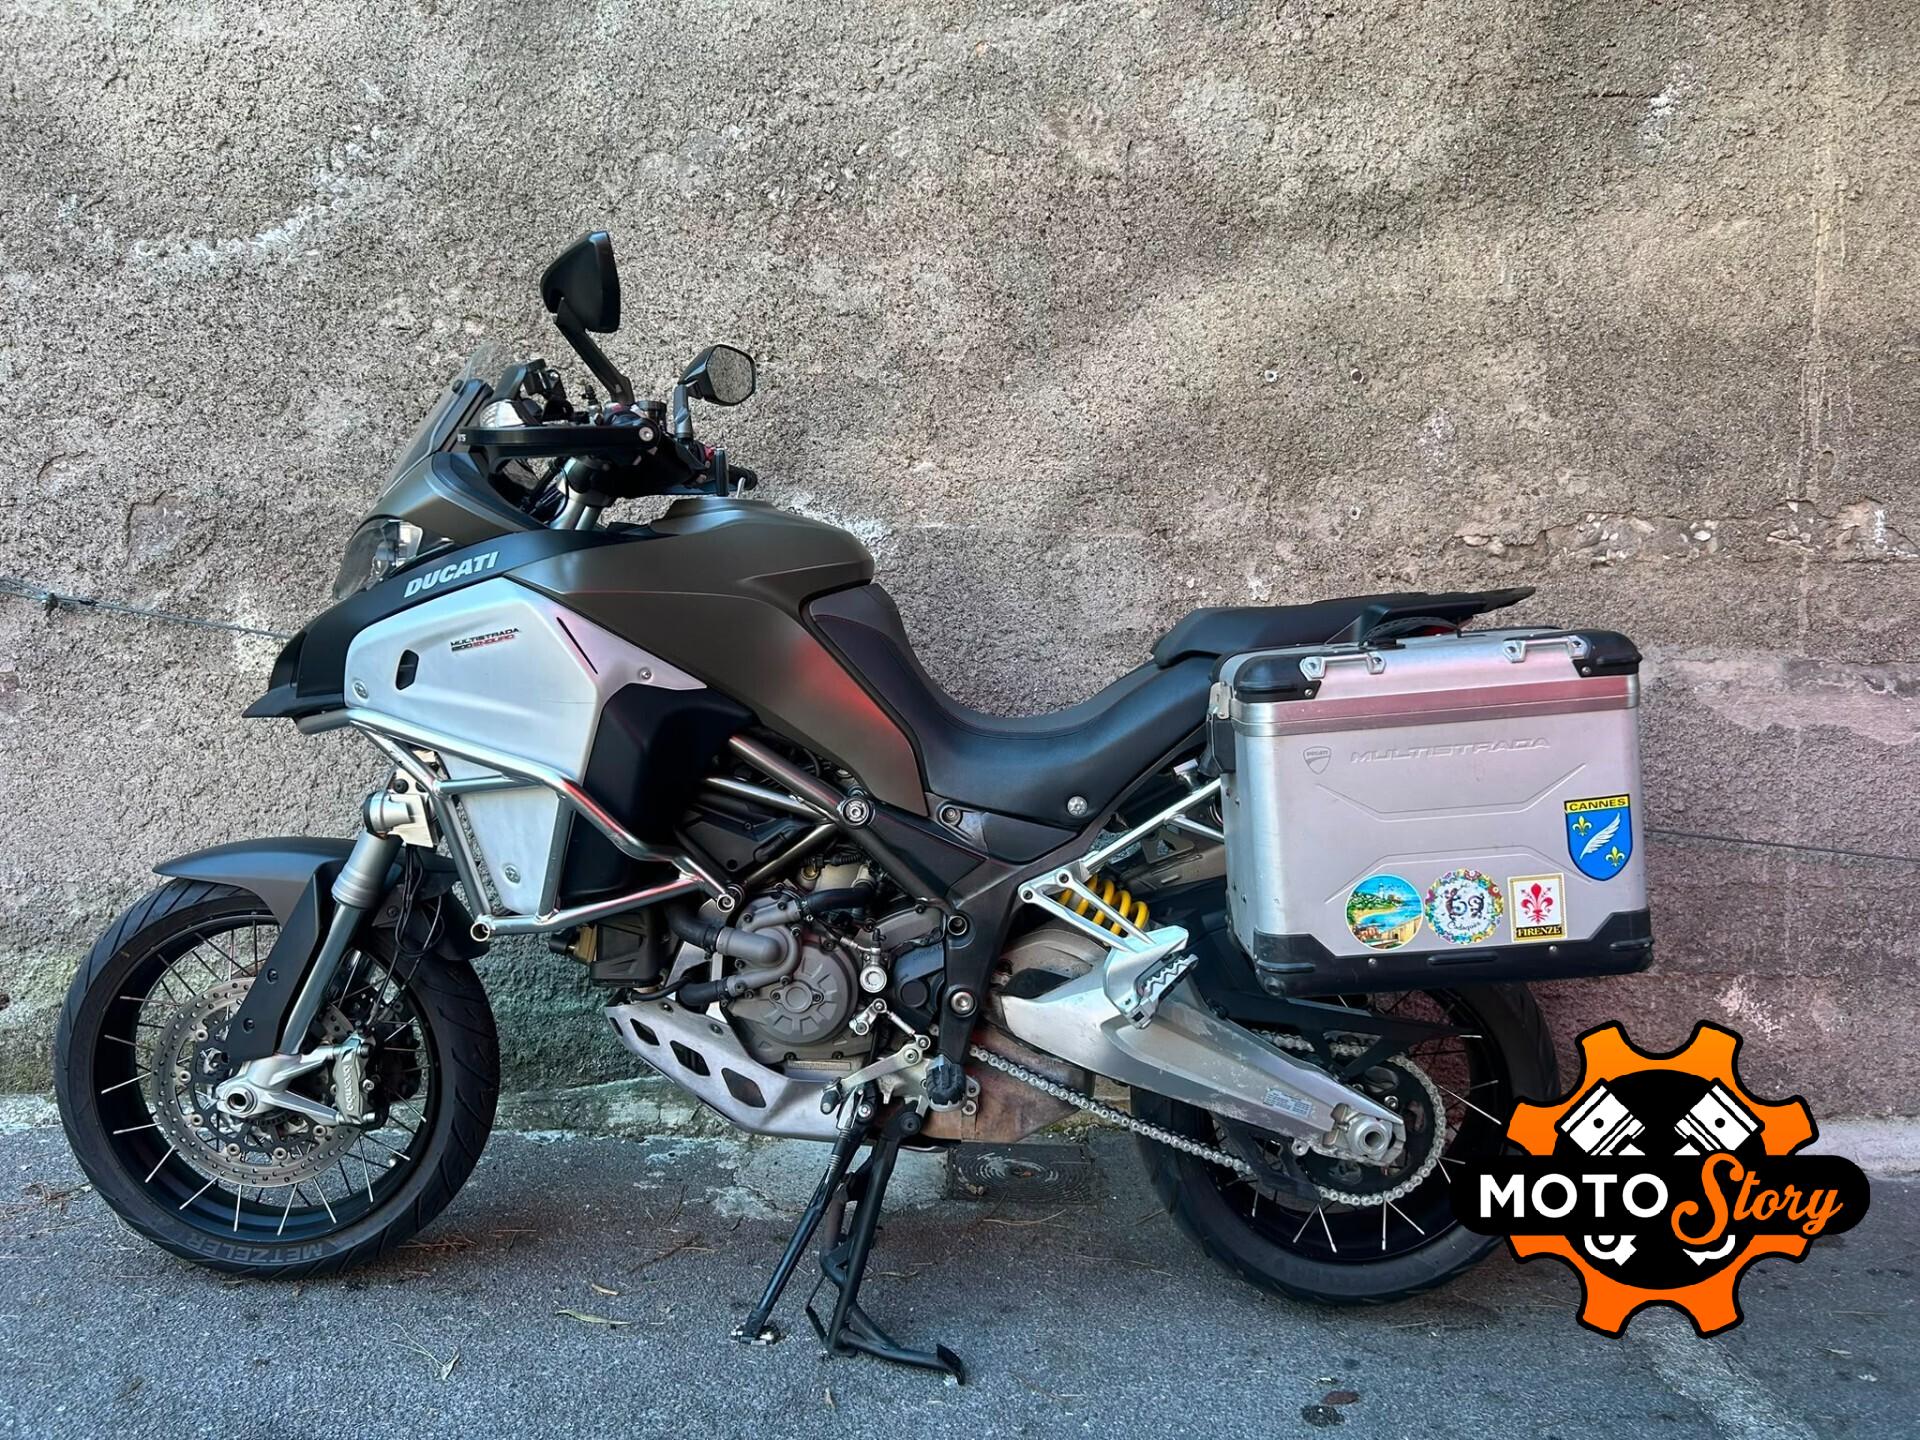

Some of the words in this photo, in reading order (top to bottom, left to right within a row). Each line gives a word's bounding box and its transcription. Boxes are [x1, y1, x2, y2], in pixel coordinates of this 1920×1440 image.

[404, 551, 499, 598] DUCATI
[450, 628, 520, 646] MULTISTRADA
[1350, 737, 1552, 764] MULTISTRADA
[1569, 797, 1626, 811] CANNES
[1518, 926, 1562, 938] FIRENZE
[186, 1235, 323, 1263] METZELER
